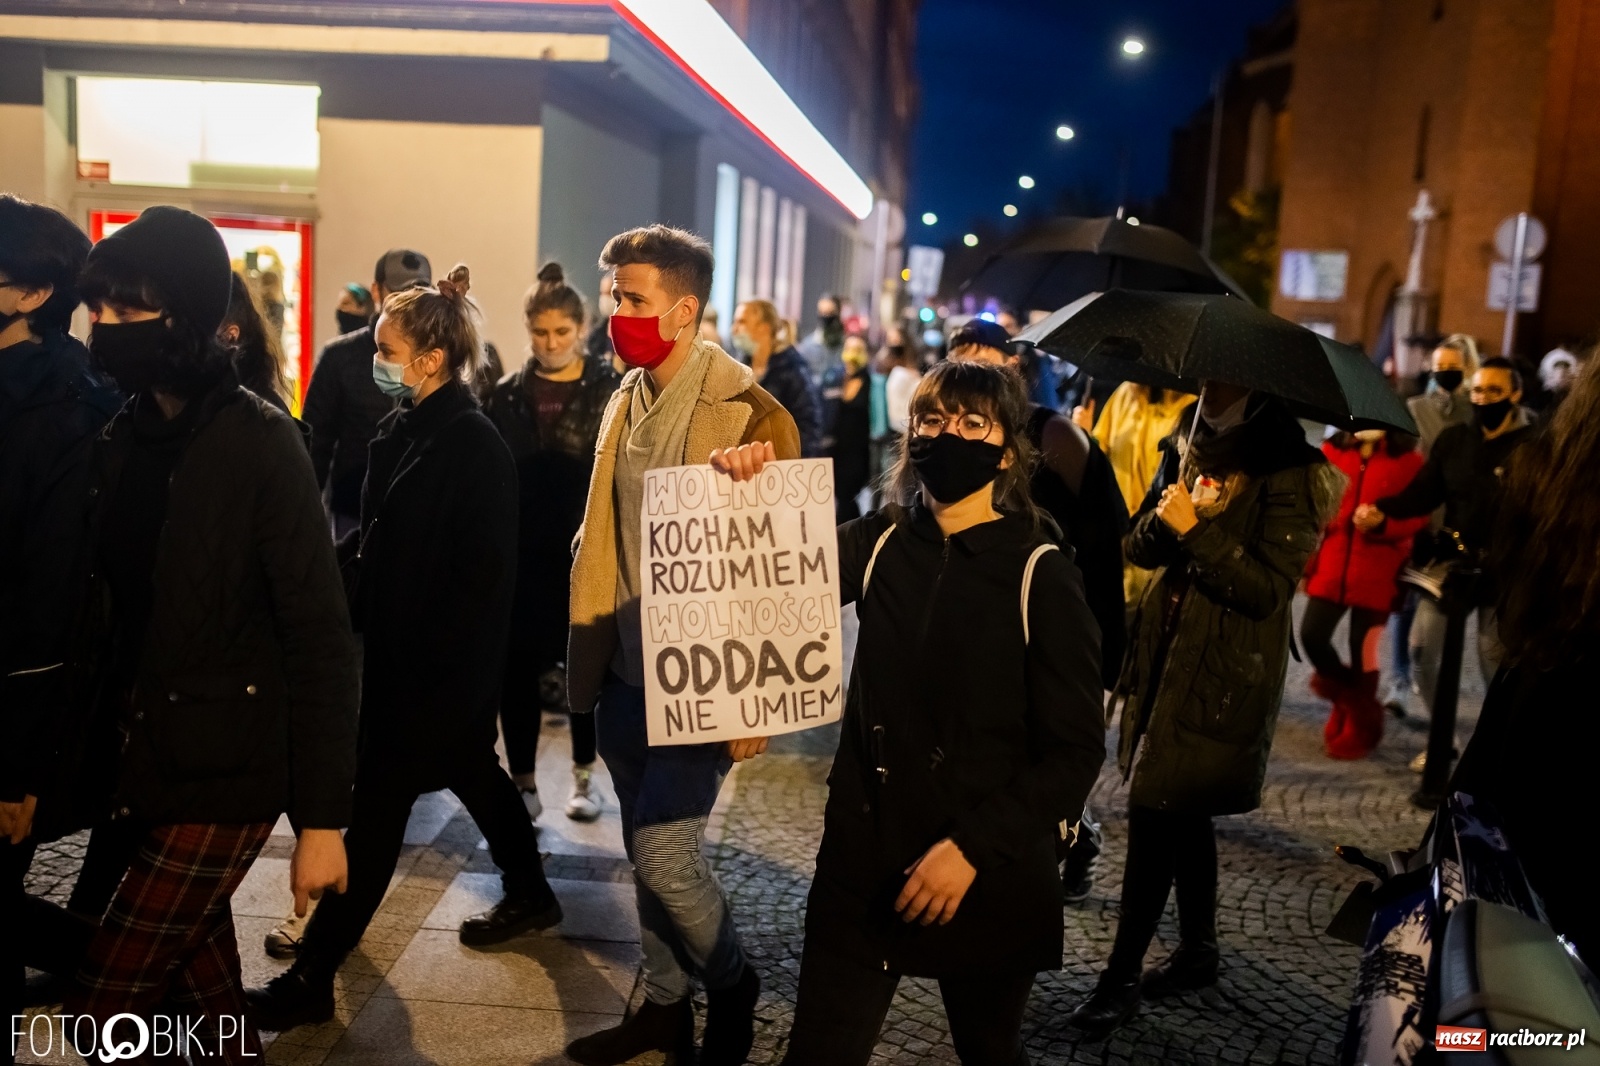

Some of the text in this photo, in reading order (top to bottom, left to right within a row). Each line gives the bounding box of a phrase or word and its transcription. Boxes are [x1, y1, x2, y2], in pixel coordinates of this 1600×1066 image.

[650, 510, 808, 558] KOCHAM I
[650, 546, 829, 595] ROZUMIEM
[648, 591, 837, 643] WOLNOŚCI
[656, 632, 831, 696] ODDAĆ
[664, 684, 840, 737] NIE UMIEM
